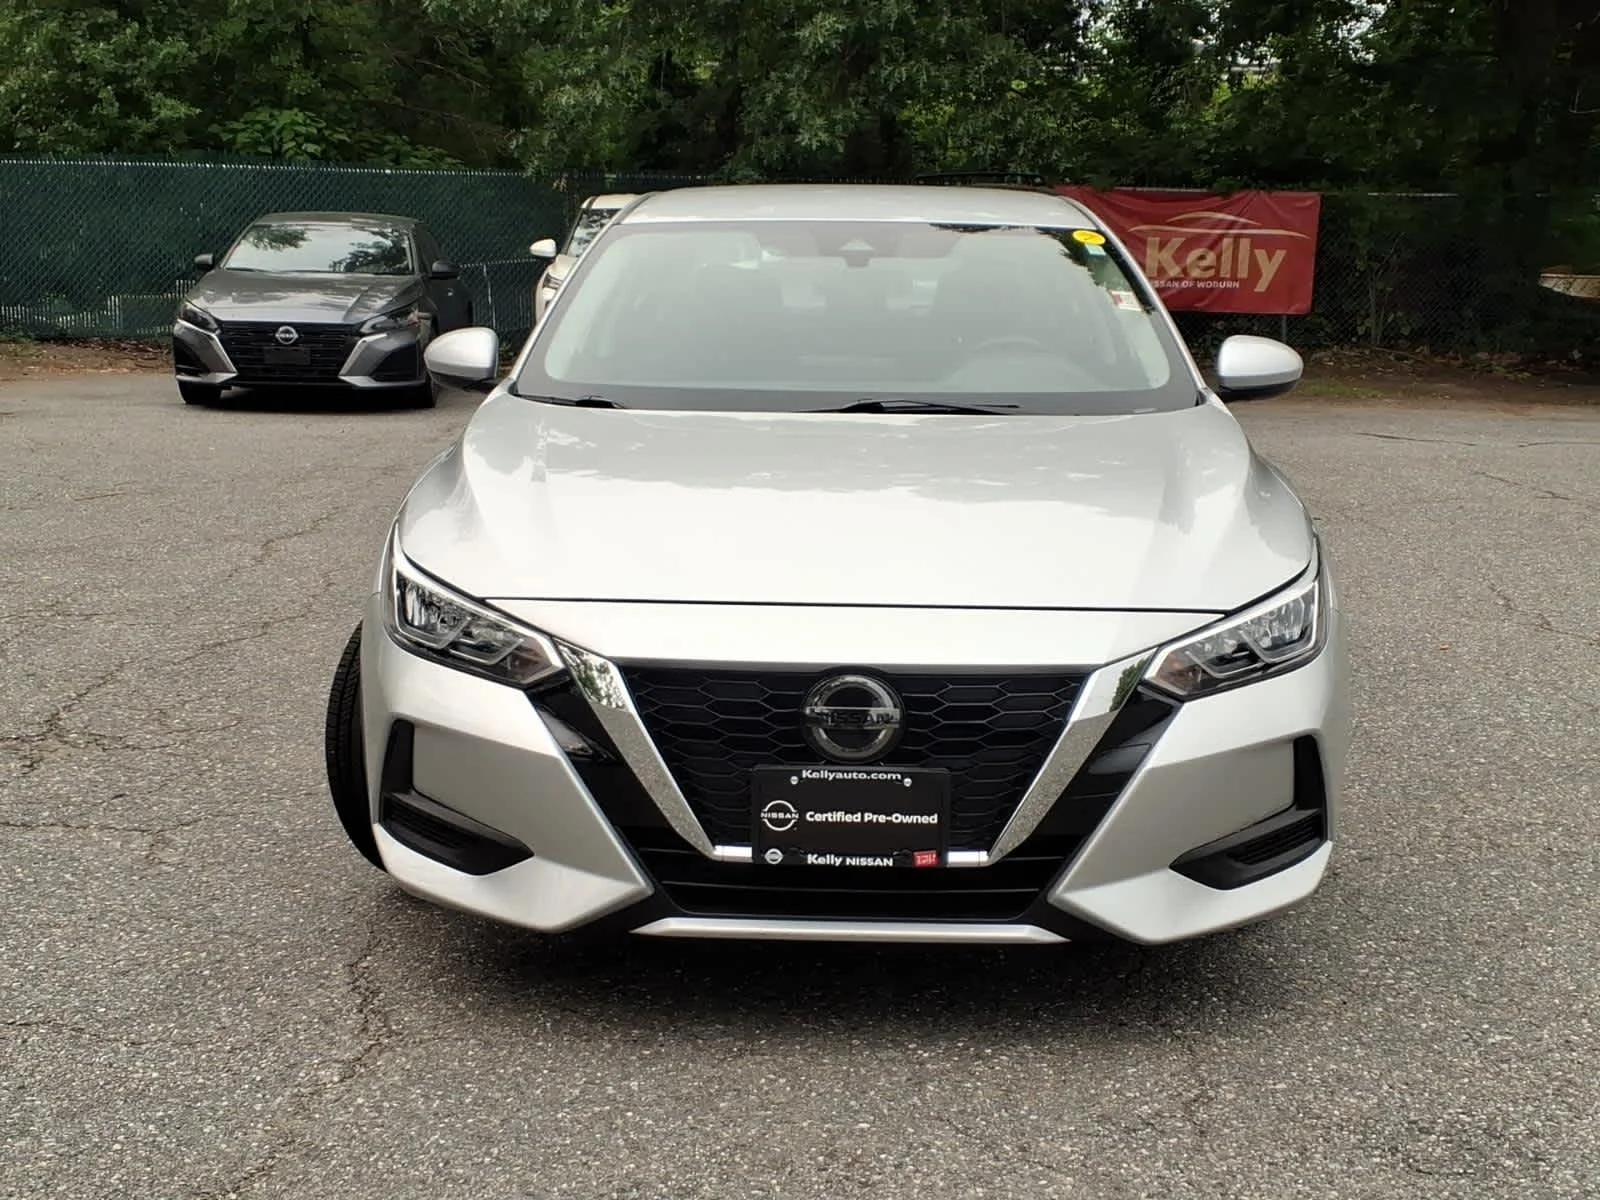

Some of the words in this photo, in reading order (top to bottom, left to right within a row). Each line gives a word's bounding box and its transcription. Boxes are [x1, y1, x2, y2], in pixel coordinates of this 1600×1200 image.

[1146, 236, 1287, 292] Kelly
[1151, 280, 1179, 290] SSAN
[1181, 280, 1194, 290] OF
[801, 769, 902, 781] Kellyauto.com
[760, 812, 799, 820] NISSAN
[806, 811, 861, 823] Certified
[864, 812, 938, 825] Pre-Owned
[807, 854, 843, 867] Kelly
[846, 857, 894, 868] NISSAN
